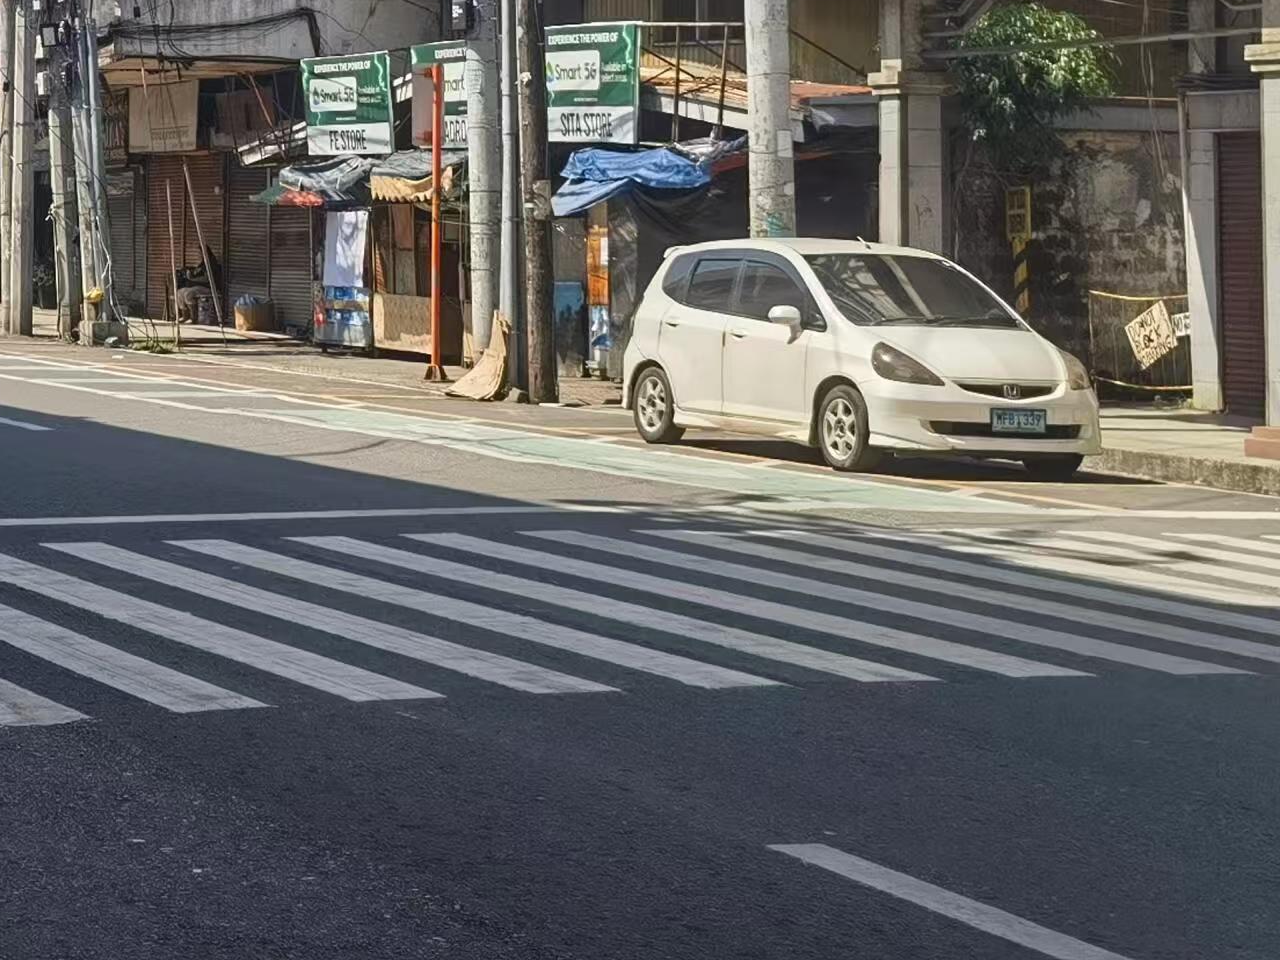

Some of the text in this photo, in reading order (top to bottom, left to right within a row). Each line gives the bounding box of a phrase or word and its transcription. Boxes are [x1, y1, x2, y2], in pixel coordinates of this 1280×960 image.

[610, 32, 619, 43] OF
[556, 62, 597, 80] Smart 5G
[444, 76, 465, 93] mart
[320, 89, 342, 103] Smart
[560, 112, 613, 137] SITA STORE
[329, 129, 367, 151] FE STORE
